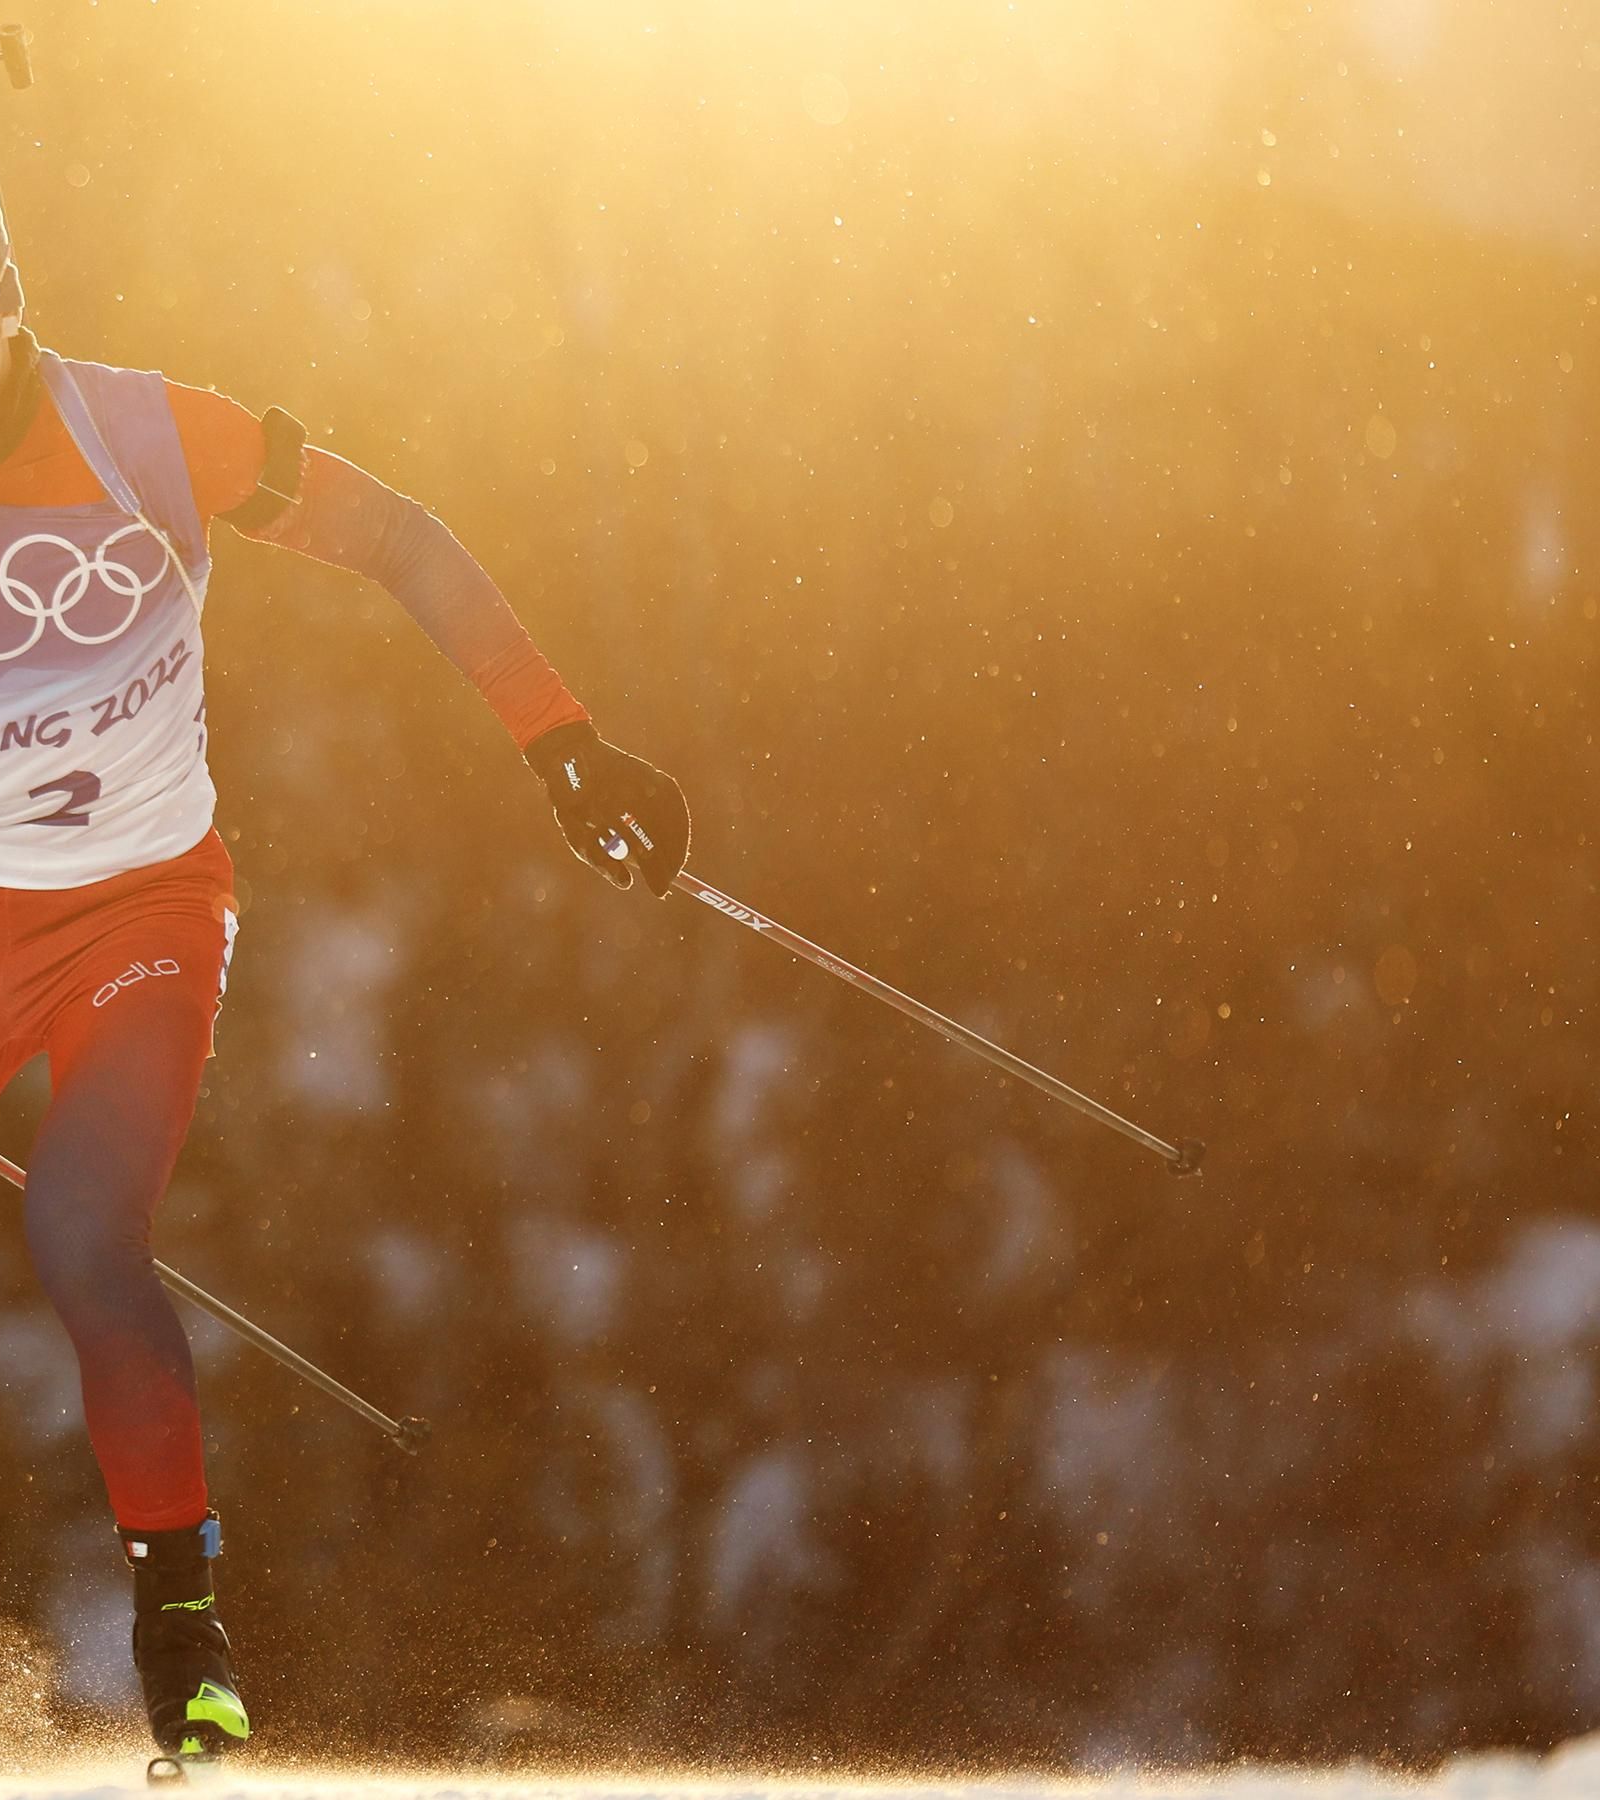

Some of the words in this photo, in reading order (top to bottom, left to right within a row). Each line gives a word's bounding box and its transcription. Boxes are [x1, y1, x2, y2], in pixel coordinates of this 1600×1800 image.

[90, 639, 194, 736] 2022
[24, 770, 102, 827] 2
[92, 959, 181, 1008] odlo
